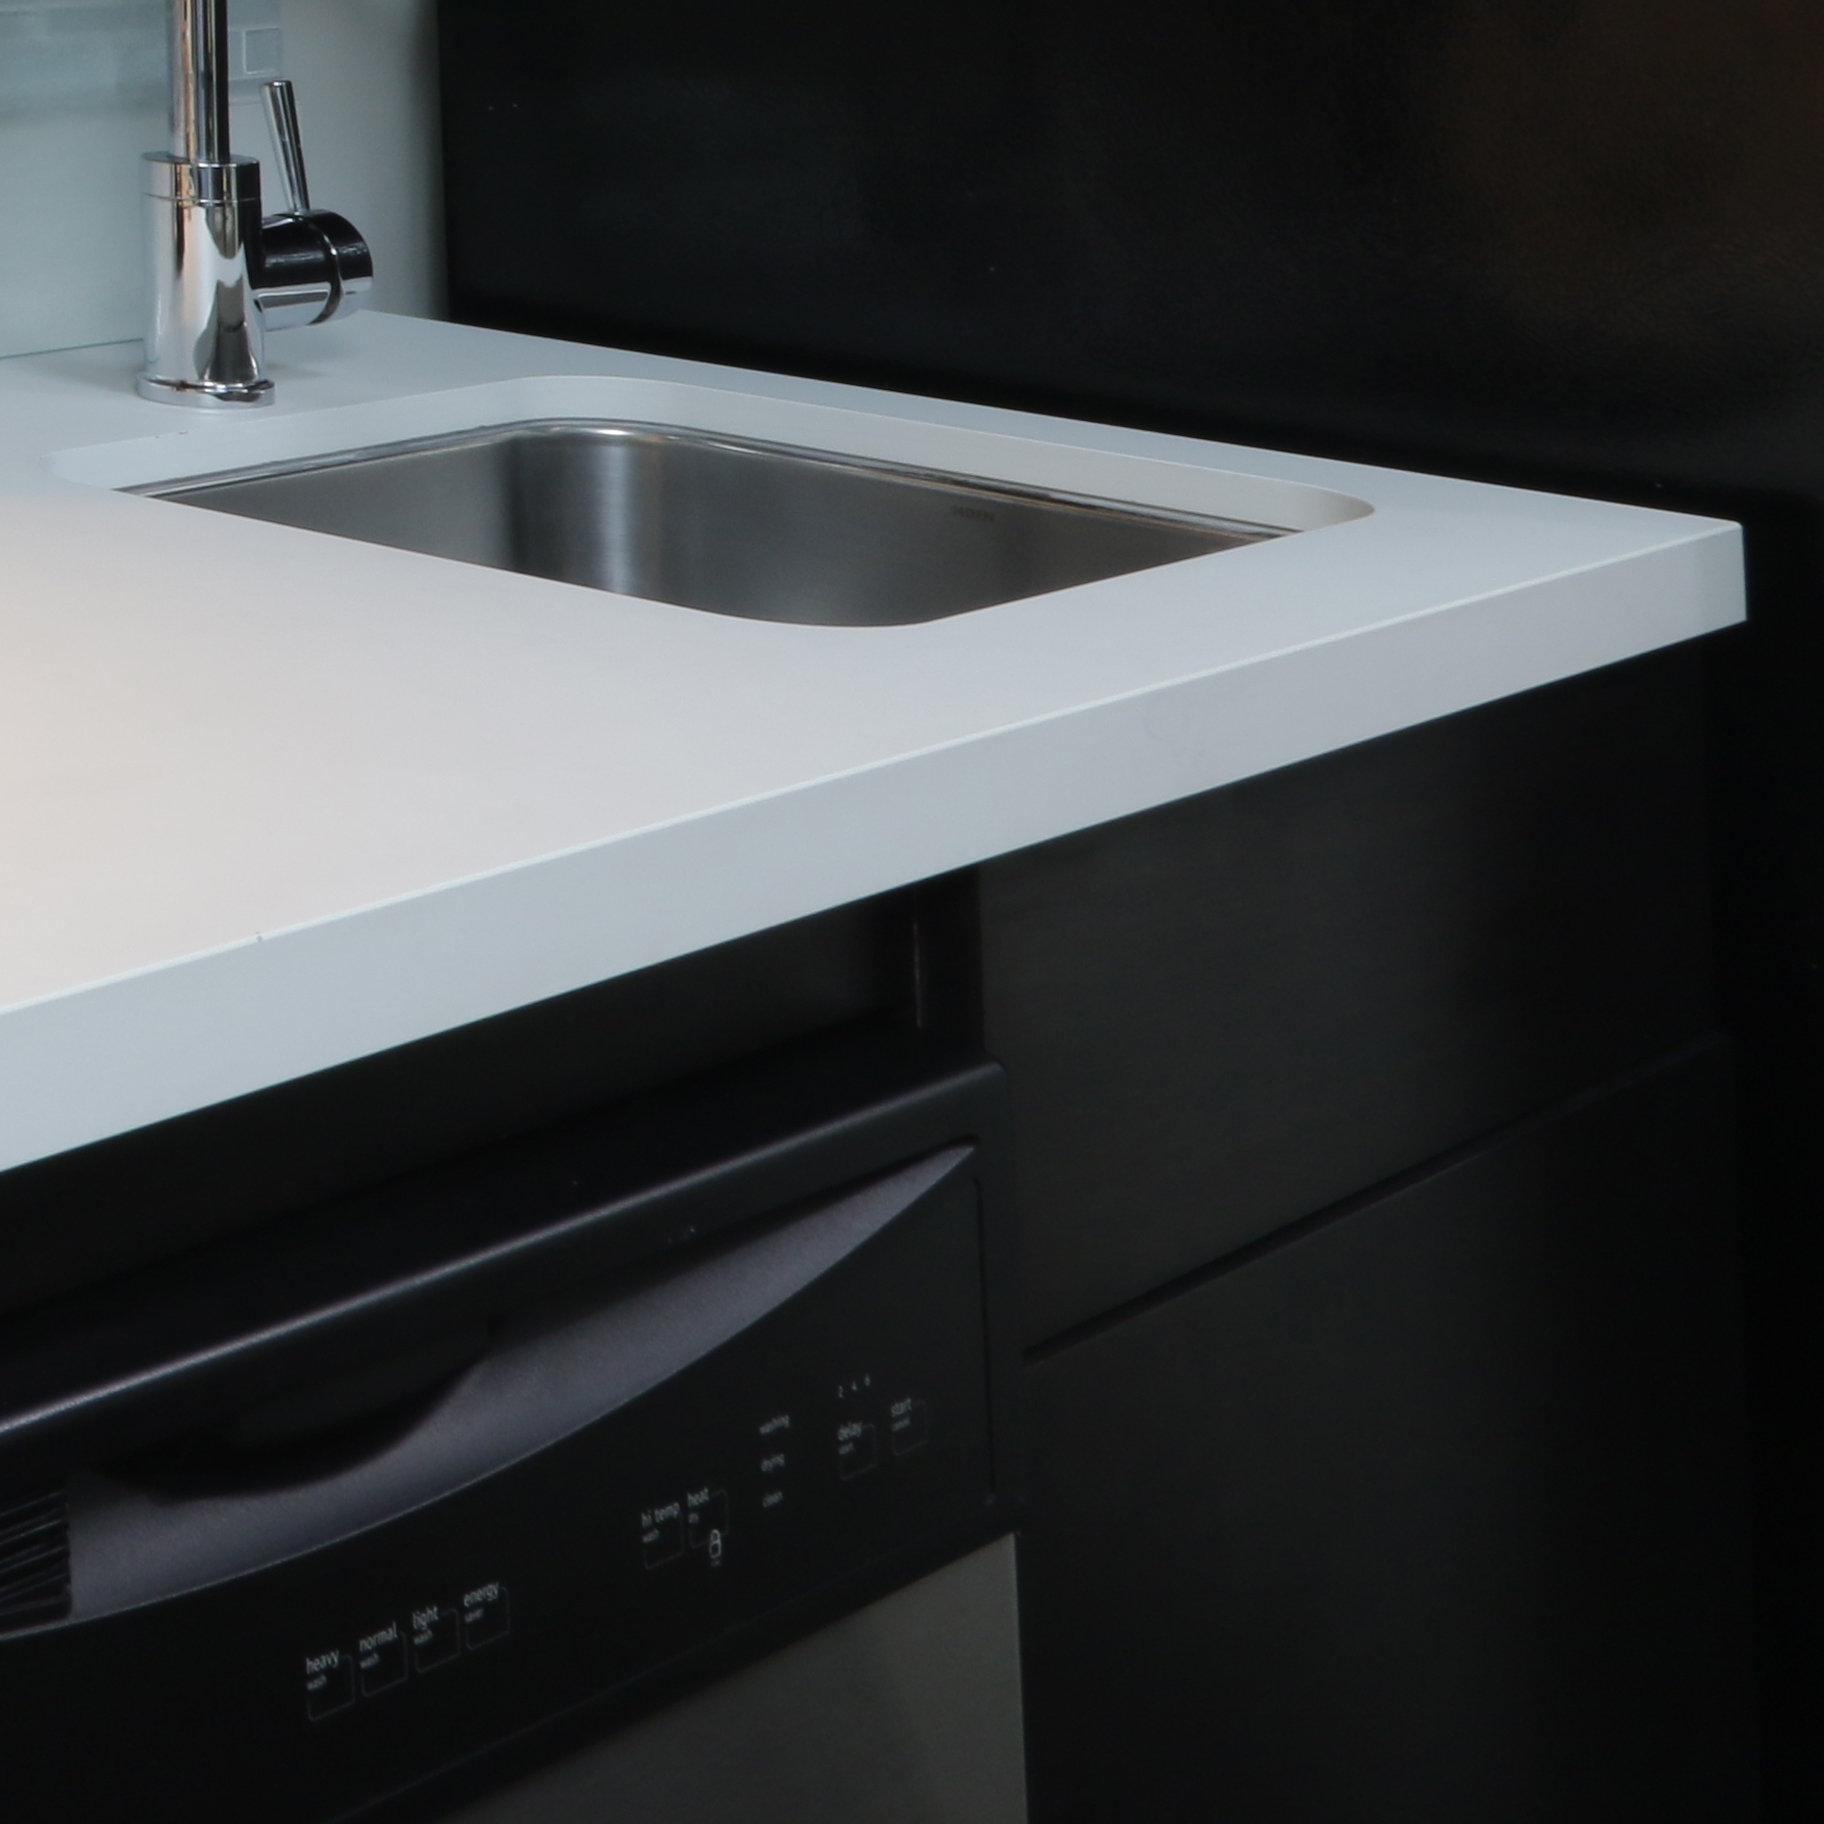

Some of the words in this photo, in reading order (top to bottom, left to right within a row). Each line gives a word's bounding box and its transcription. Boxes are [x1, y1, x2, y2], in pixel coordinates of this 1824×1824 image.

[687, 1487, 710, 1507] heat
[655, 1502, 680, 1523] temp
[463, 1581, 500, 1608] energy
[412, 1605, 439, 1631] light
[359, 1621, 398, 1652] normal
[305, 1648, 340, 1675] heavy
